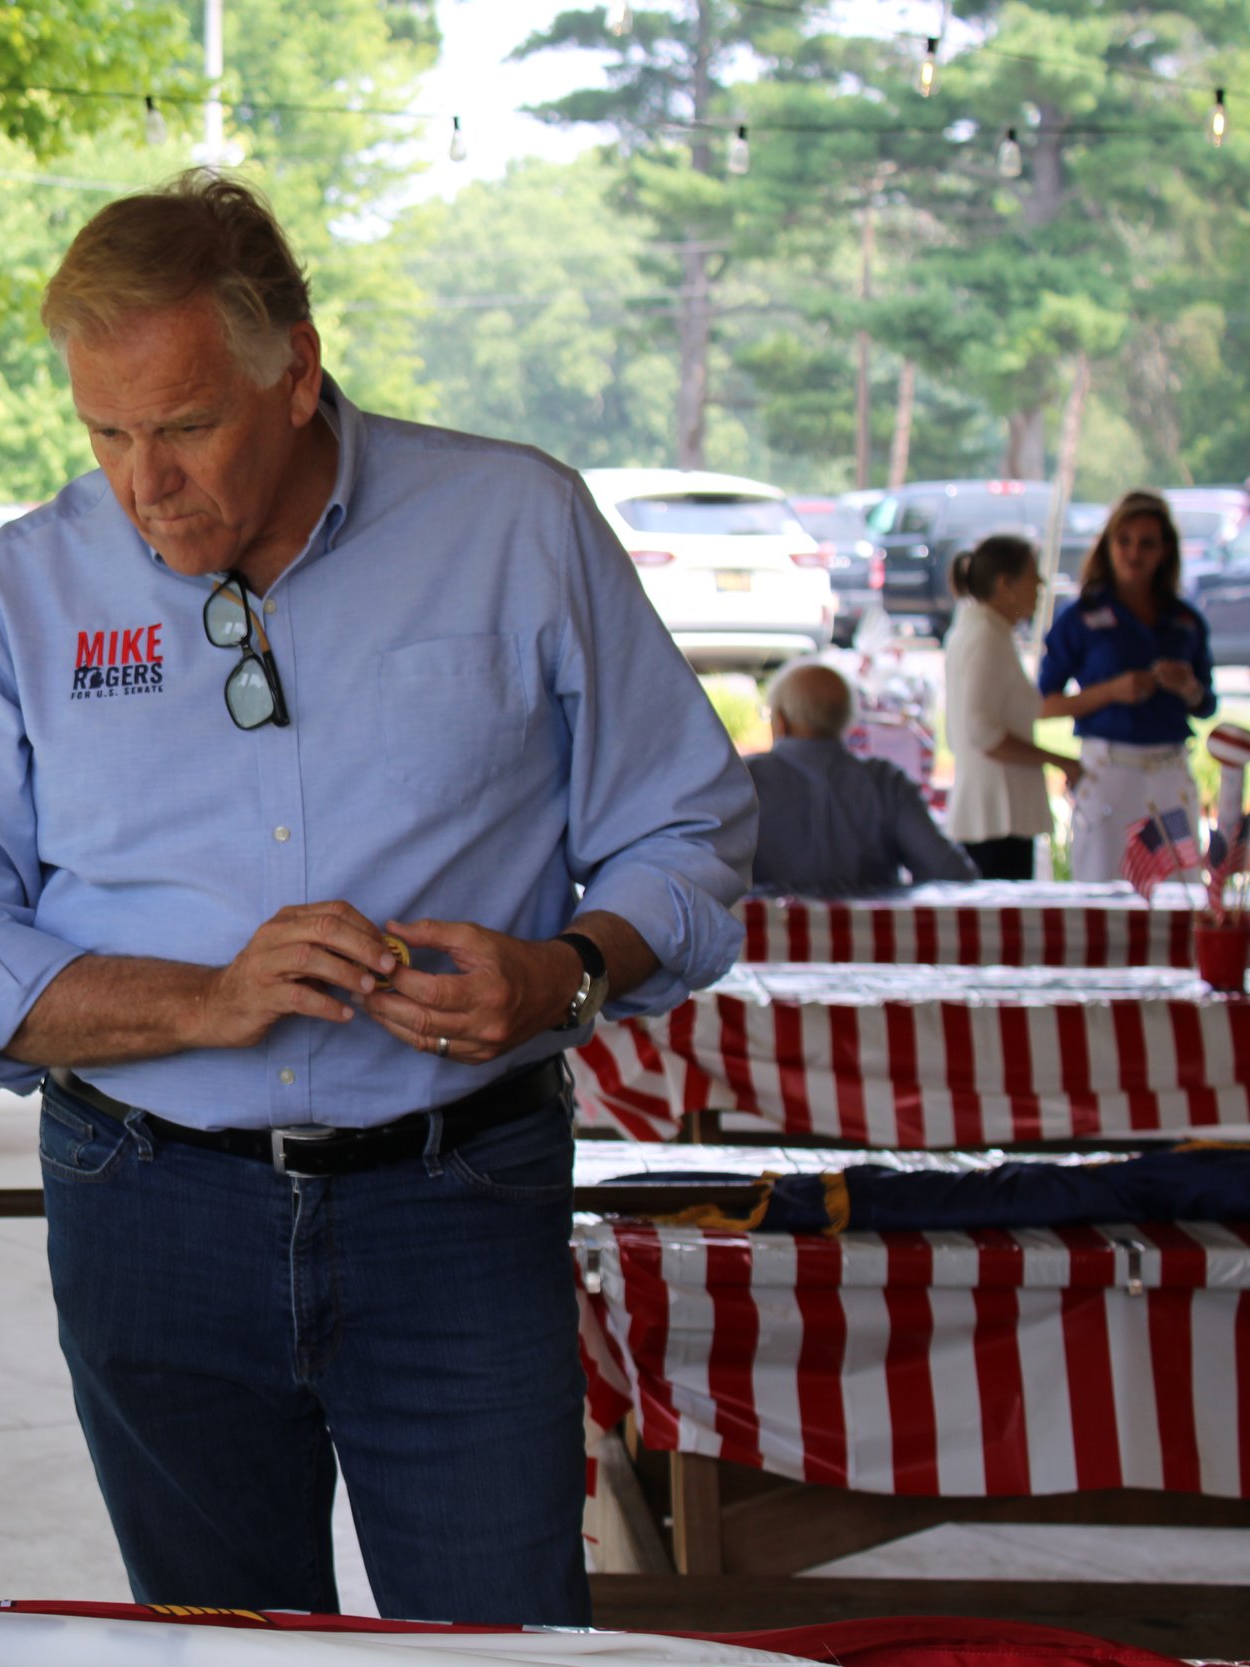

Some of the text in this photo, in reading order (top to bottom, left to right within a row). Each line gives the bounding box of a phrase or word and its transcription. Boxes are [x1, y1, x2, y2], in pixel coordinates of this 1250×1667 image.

[76, 623, 163, 668] MIKE
[73, 662, 163, 690] ROGERS
[71, 685, 163, 700] FOR U.S. SENATE
